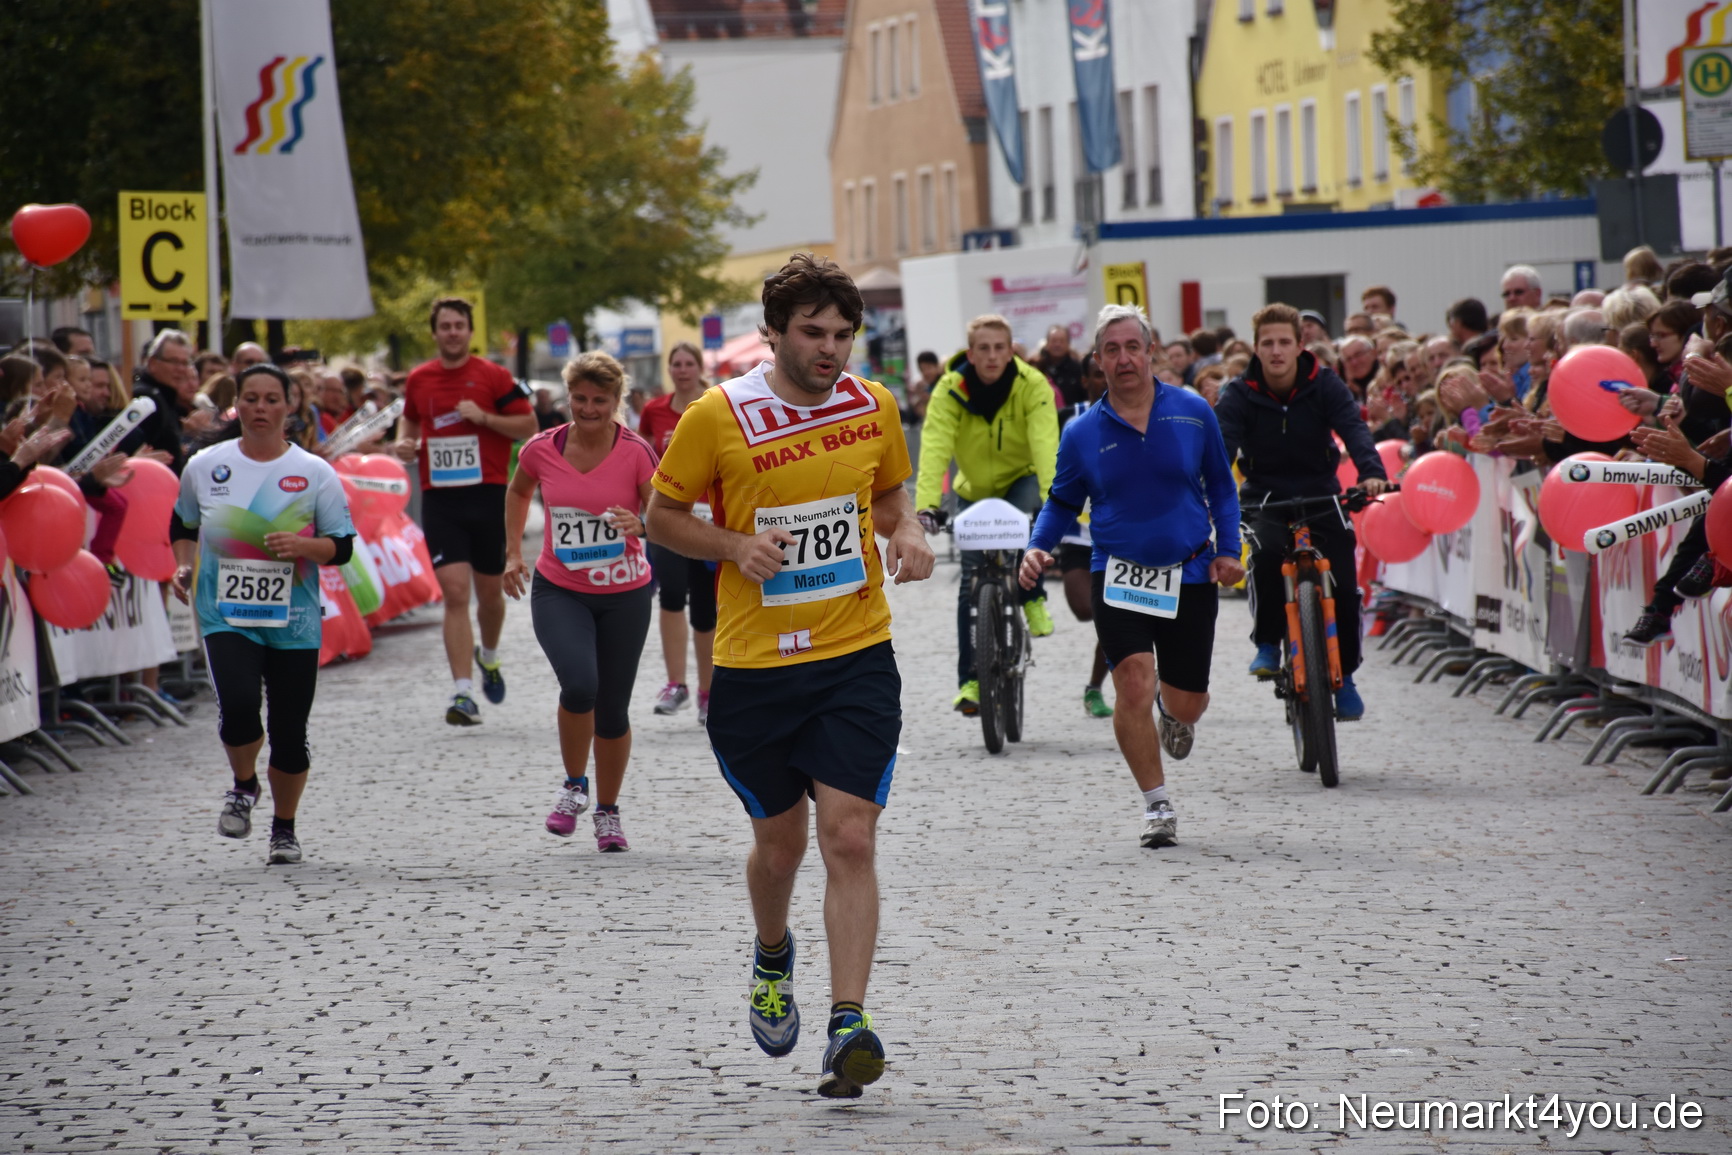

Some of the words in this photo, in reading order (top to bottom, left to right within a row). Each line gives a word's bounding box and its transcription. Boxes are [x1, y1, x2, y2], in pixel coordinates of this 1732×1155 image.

[130, 198, 196, 221] Block
[141, 231, 185, 293] C
[1116, 283, 1138, 305] D
[751, 441, 817, 474] MAX
[821, 421, 883, 453] BÖGL
[434, 449, 476, 468] 3075
[552, 511, 573, 520] PARTL
[757, 516, 792, 527] PARTL
[793, 507, 841, 524] Neumarkt
[963, 519, 992, 528] Erster
[994, 518, 1020, 527] Mann
[557, 520, 618, 545] 2178
[1624, 511, 1668, 540] BMW
[959, 532, 1024, 541] Halbmarathon
[571, 548, 608, 561] Daniela
[220, 563, 245, 572] PARTL
[246, 566, 281, 574] Neumarkt
[1113, 562, 1172, 592] 2821
[225, 574, 285, 602] 2582
[793, 571, 836, 590] Marco
[1123, 590, 1160, 607] Thomas
[230, 606, 274, 618] Jeannine
